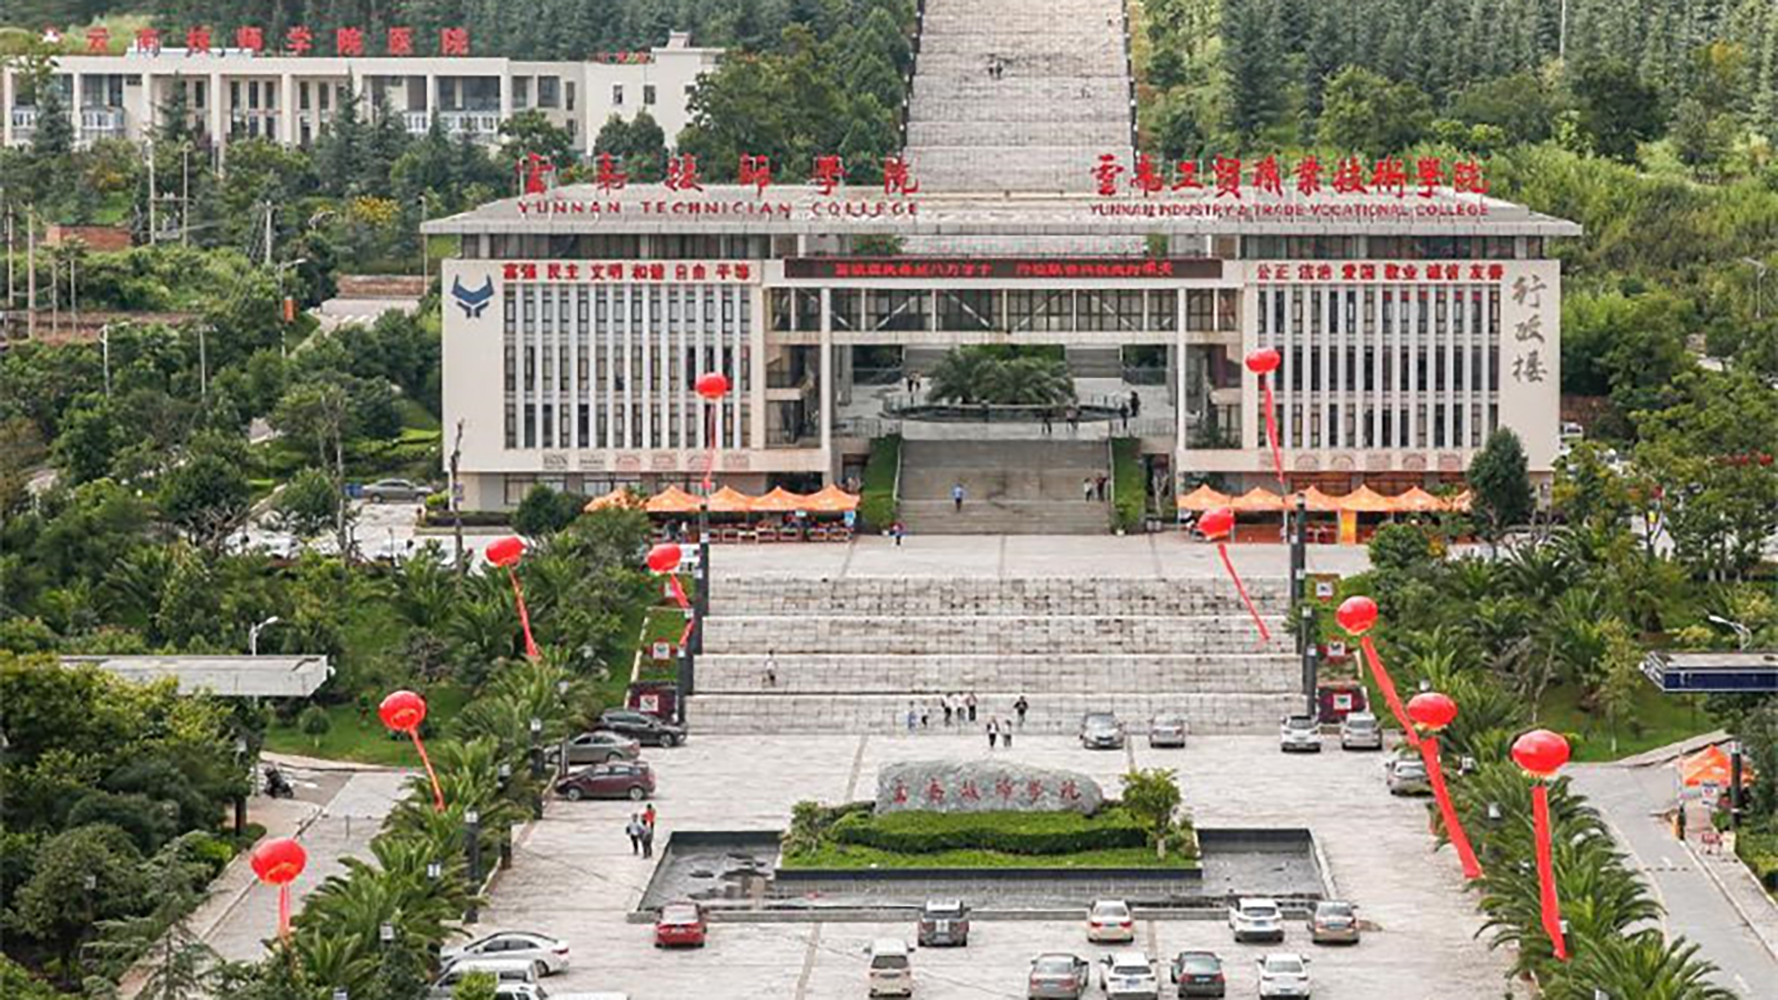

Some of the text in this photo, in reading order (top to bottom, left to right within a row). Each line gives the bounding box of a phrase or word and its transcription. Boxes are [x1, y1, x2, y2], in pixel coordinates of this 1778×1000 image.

[517, 201, 621, 214] YUNNAN
[640, 201, 793, 216] TECHNICIAN
[1090, 203, 1154, 217] YUNNAN
[1158, 203, 1231, 217] INDUSTRY
[1252, 203, 1305, 217] TRADE
[1309, 203, 1410, 217] VOCATIONAL
[1415, 203, 1490, 217] COLLEGE
[503, 263, 538, 281] 富强
[546, 263, 579, 281] 民主
[590, 263, 624, 281] 文明
[716, 263, 750, 281] 平等
[1257, 263, 1290, 281] 公正
